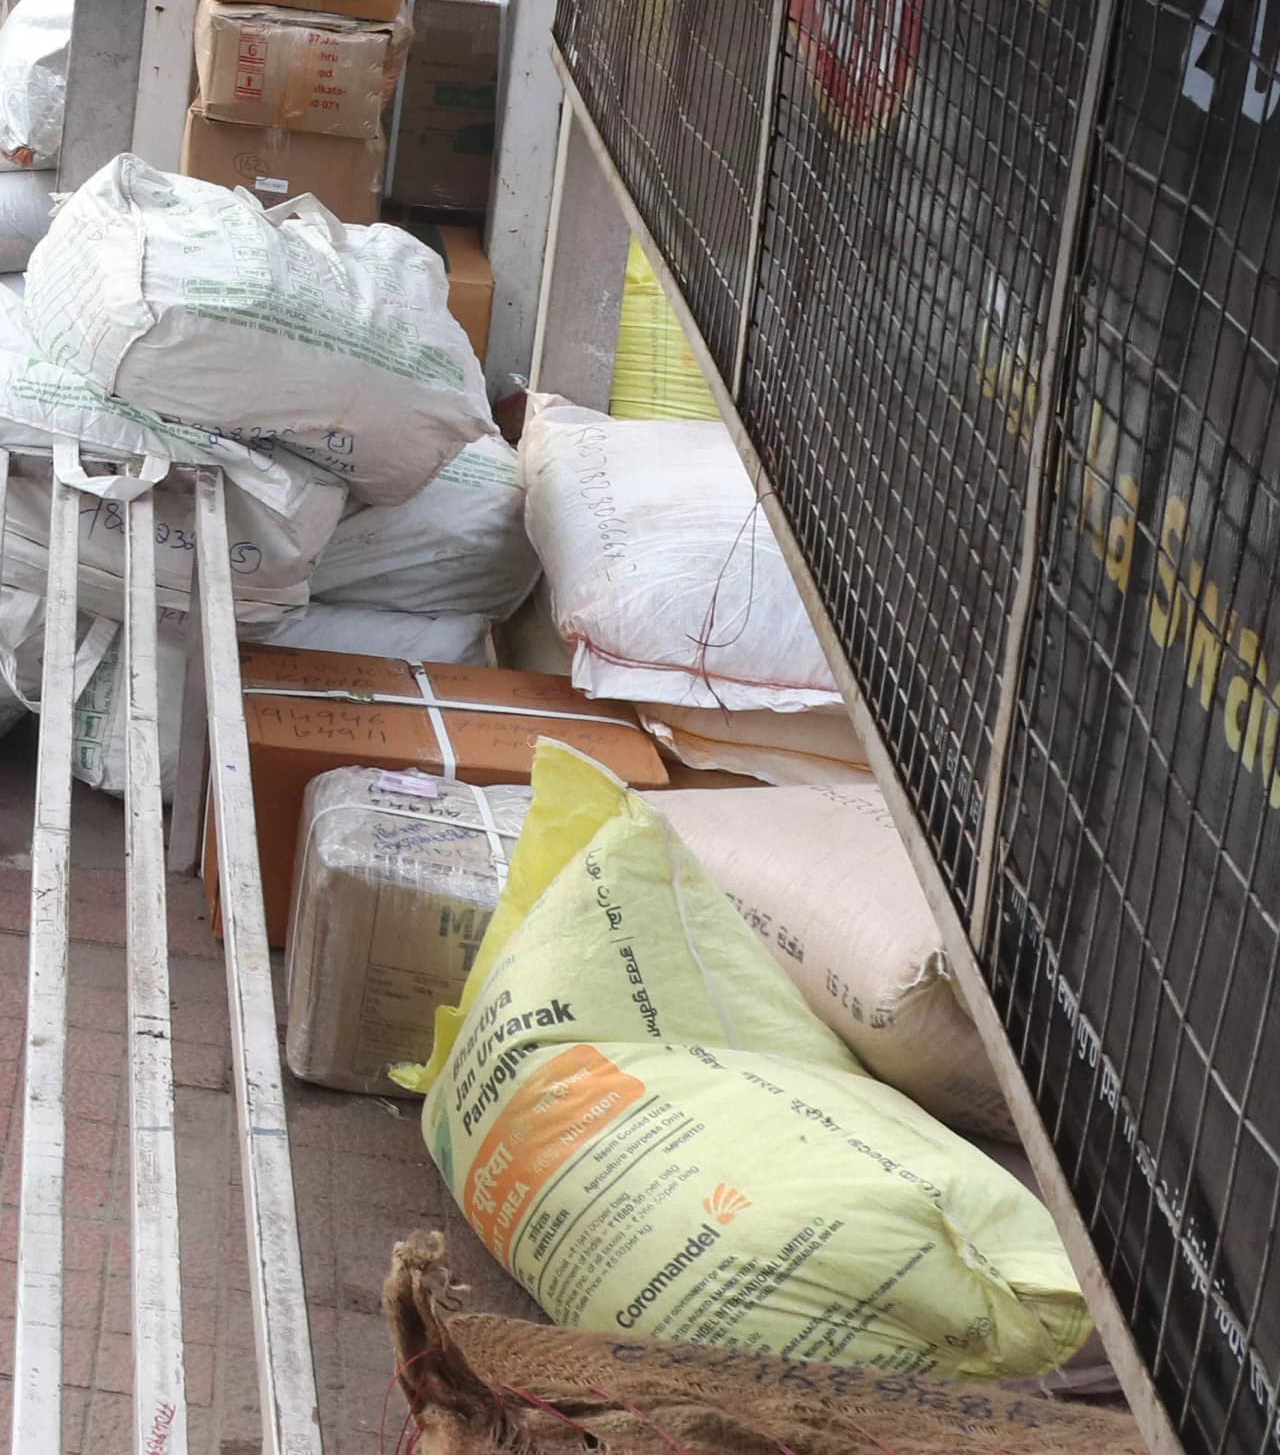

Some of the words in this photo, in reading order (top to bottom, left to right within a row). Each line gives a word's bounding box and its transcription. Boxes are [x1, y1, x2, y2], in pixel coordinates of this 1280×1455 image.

[455, 1068, 476, 1111] Jan
[476, 999, 576, 1067] Urvarak
[559, 1090, 622, 1146] Nitrogen
[584, 1151, 629, 1194] Agriculture
[627, 1128, 662, 1156] purpose
[661, 1111, 685, 1131] Only
[593, 1134, 618, 1162] Neem
[617, 1117, 648, 1141] Coated
[649, 1102, 673, 1121] Urea
[500, 1181, 530, 1227] UREA
[533, 1208, 571, 1262] FERTILISER
[616, 1223, 722, 1329] Coromandel
[716, 1258, 779, 1315] INTERNATIONAL
[778, 1226, 815, 1261] LIMITED
